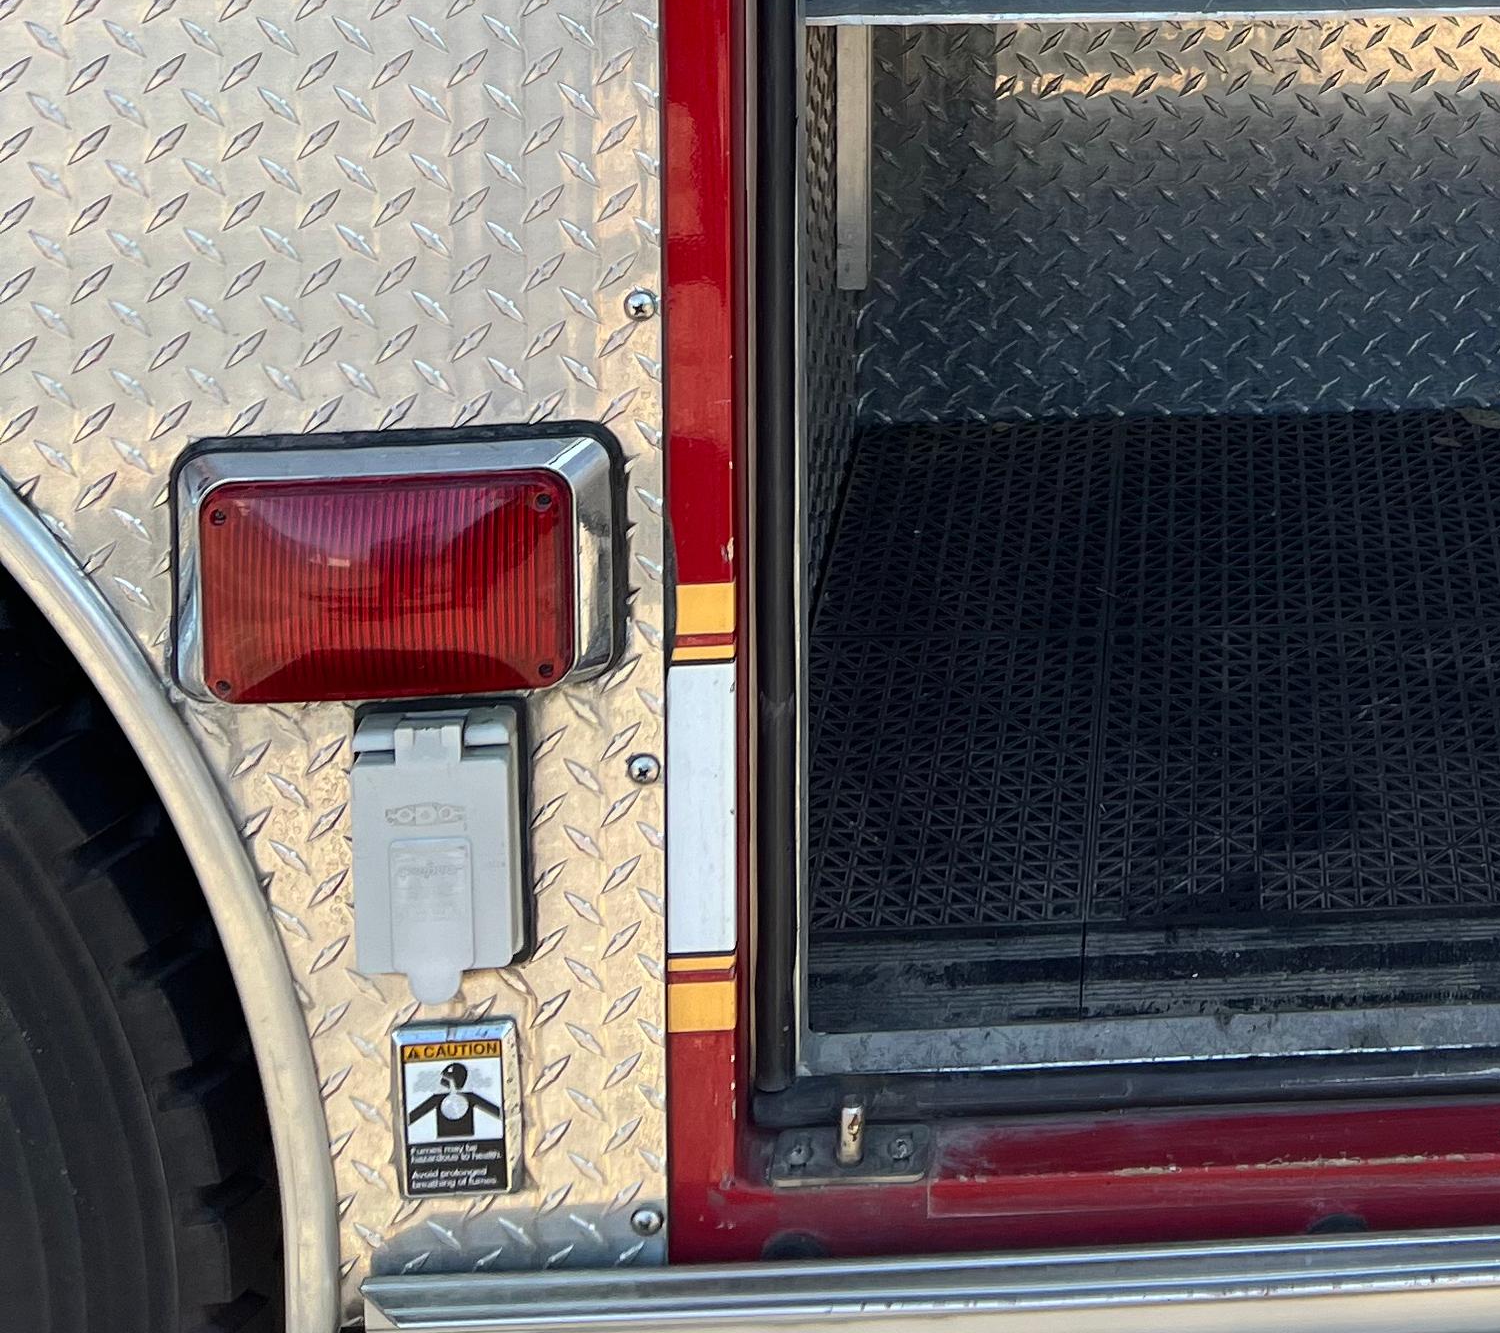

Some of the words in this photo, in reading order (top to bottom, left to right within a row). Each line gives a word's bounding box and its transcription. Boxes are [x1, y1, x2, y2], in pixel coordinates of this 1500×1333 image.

[424, 1042, 498, 1058] CAUTION
[443, 1144, 464, 1155] may
[460, 1152, 470, 1161] to
[412, 1168, 439, 1179] Avoid
[457, 1175, 468, 1186] of
